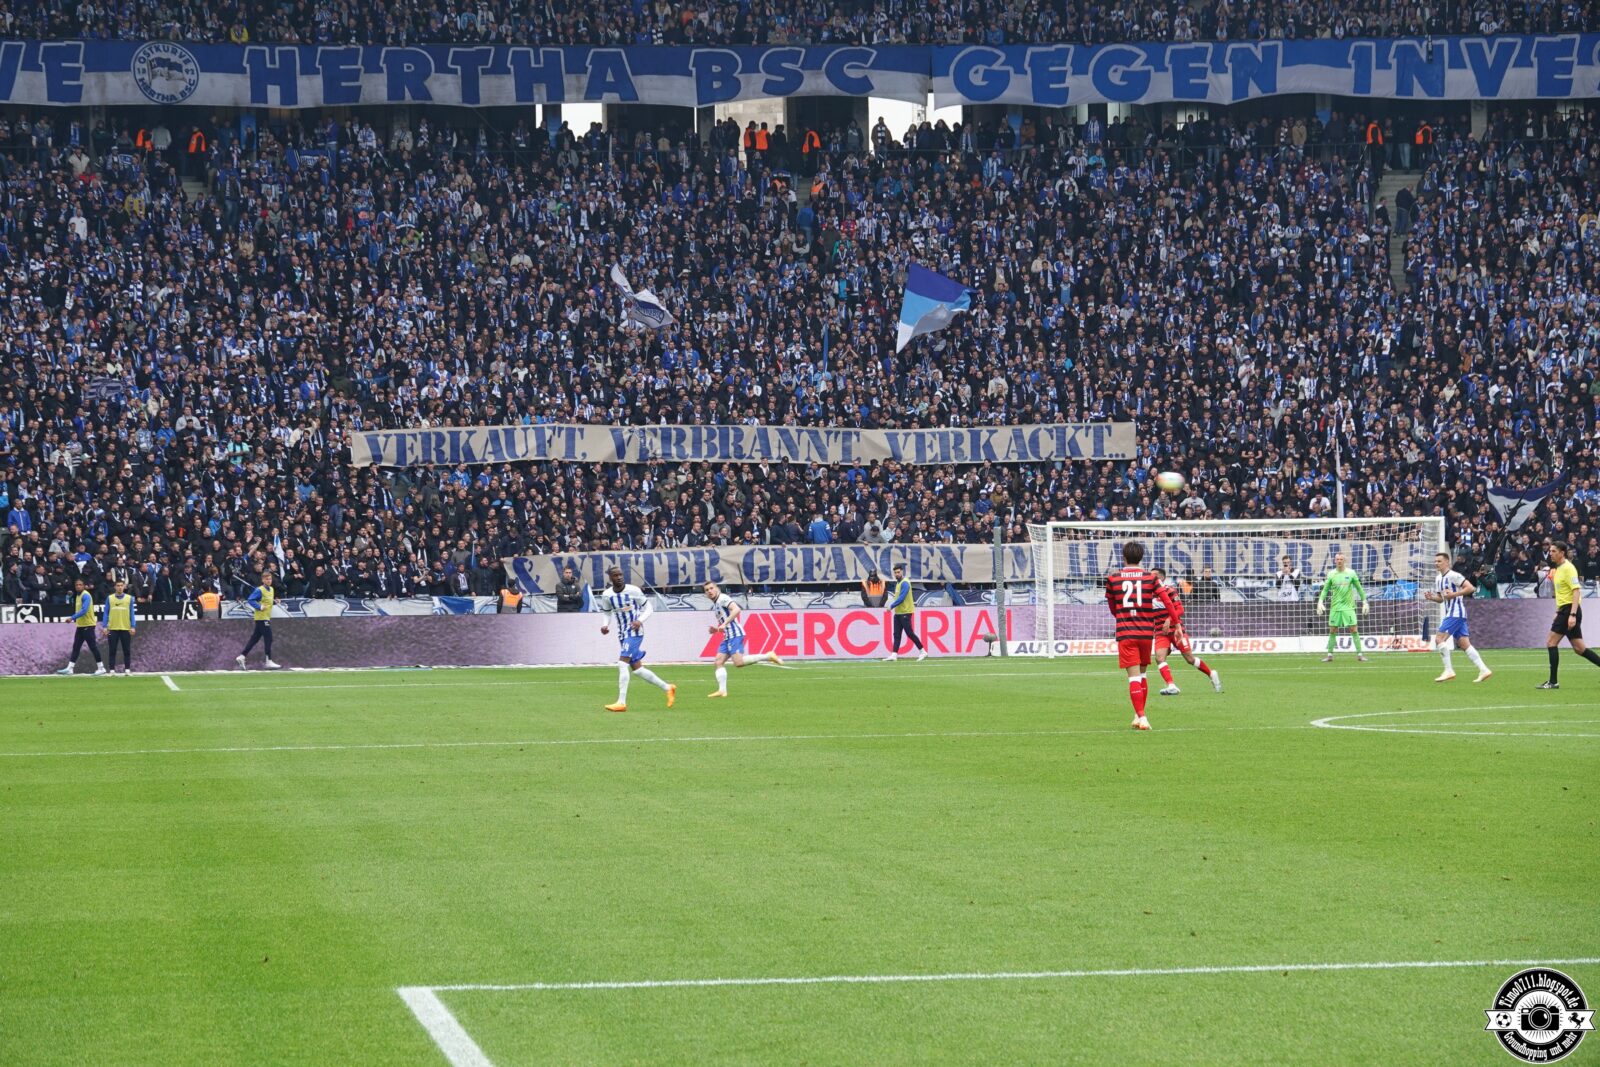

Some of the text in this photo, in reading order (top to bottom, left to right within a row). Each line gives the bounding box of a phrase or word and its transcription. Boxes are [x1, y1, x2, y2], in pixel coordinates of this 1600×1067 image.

[138, 45, 192, 65] OSTKURVE
[243, 46, 877, 106] HERTHA BSC
[949, 34, 1600, 104] GEGEN INVE
[138, 77, 196, 102] HERTHA BSC
[364, 425, 588, 467] VERKAUFT,
[883, 425, 1126, 464] VERKACKT...
[512, 557, 545, 594] &
[742, 545, 967, 583] GEFANGEN
[1121, 580, 1143, 608] 21
